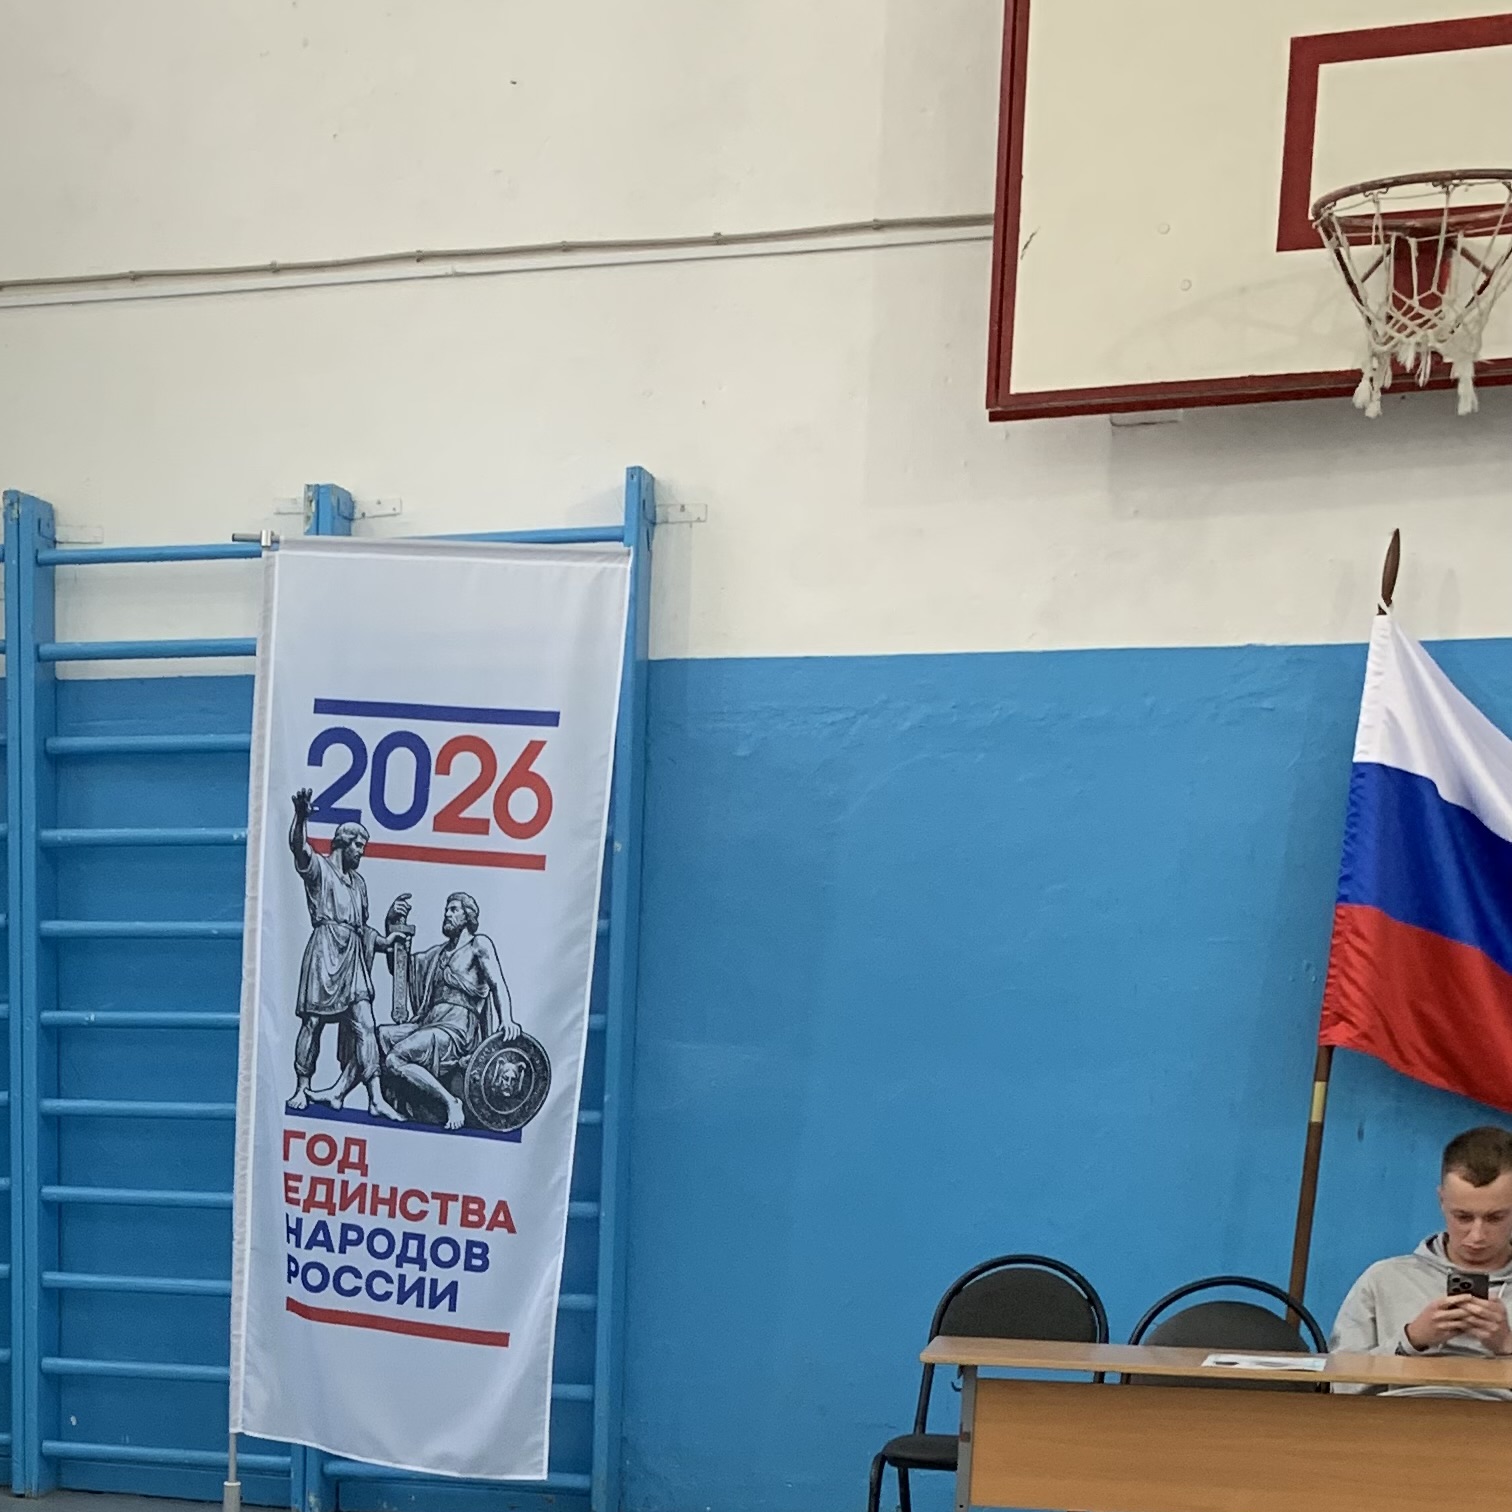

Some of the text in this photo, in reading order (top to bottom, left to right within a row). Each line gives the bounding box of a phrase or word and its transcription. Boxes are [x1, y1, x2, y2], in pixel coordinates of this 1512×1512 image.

[307, 727, 553, 840] 2026
[283, 1129, 369, 1177] ГОД
[283, 1172, 517, 1234] ЕДИНСТВА
[286, 1212, 490, 1273] НАРОДОВ
[287, 1253, 459, 1312] РОССИИ
